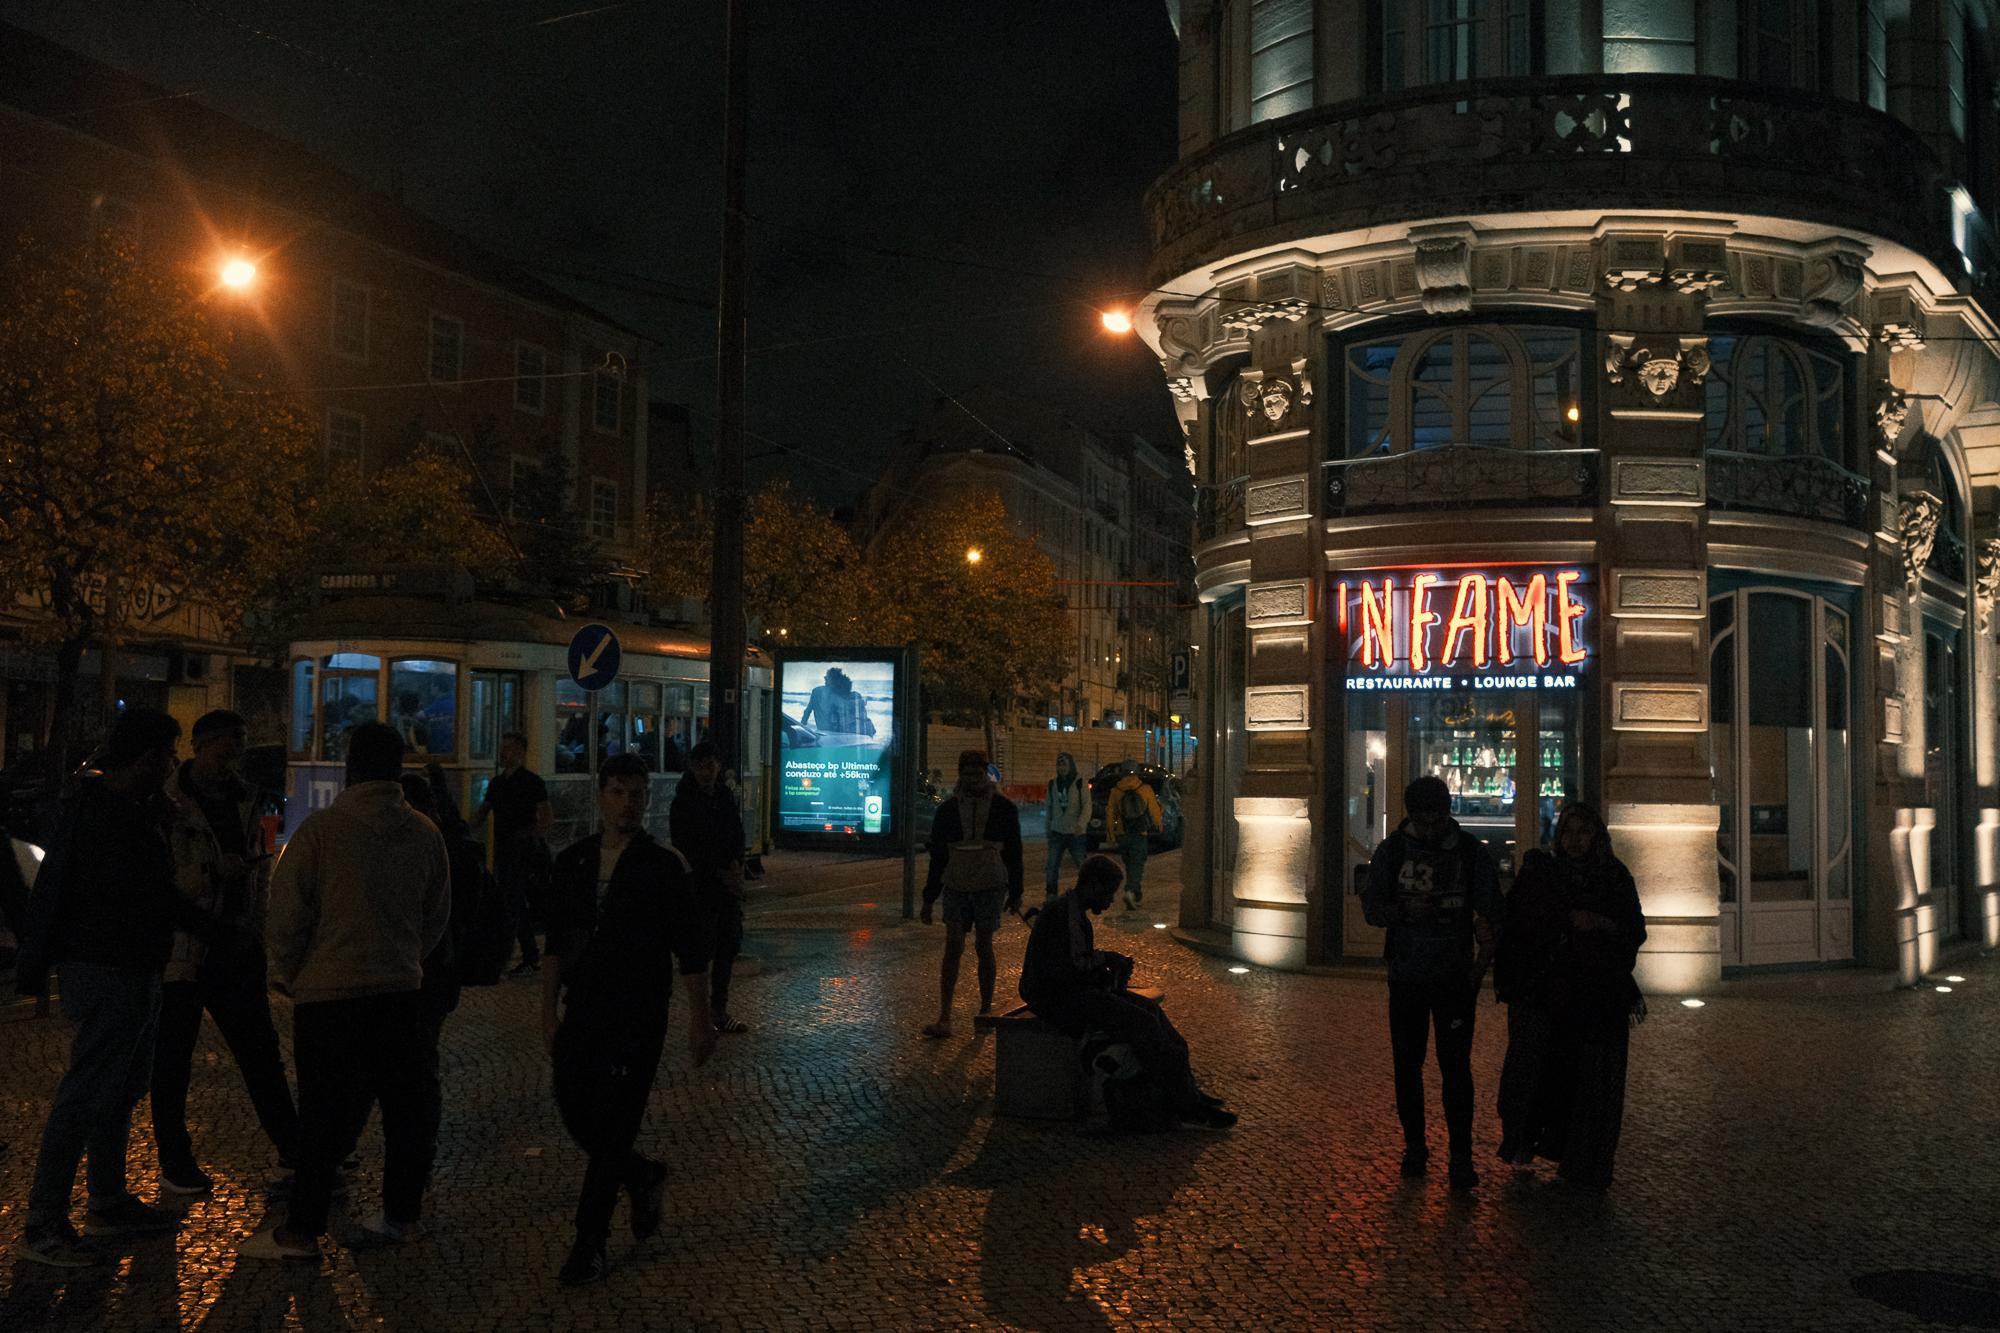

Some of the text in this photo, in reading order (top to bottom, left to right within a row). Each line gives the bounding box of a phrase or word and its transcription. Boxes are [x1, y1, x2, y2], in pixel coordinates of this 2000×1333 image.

[1338, 571, 1587, 671] INFAME
[1174, 655, 1186, 687] P
[1346, 676, 1576, 690] RESTAURANTE LOUNGE BAR
[785, 761, 881, 772] Abasteço bp Ultimate,
[785, 770, 870, 779] conduzo até +56km
[1398, 860, 1434, 891] 43
